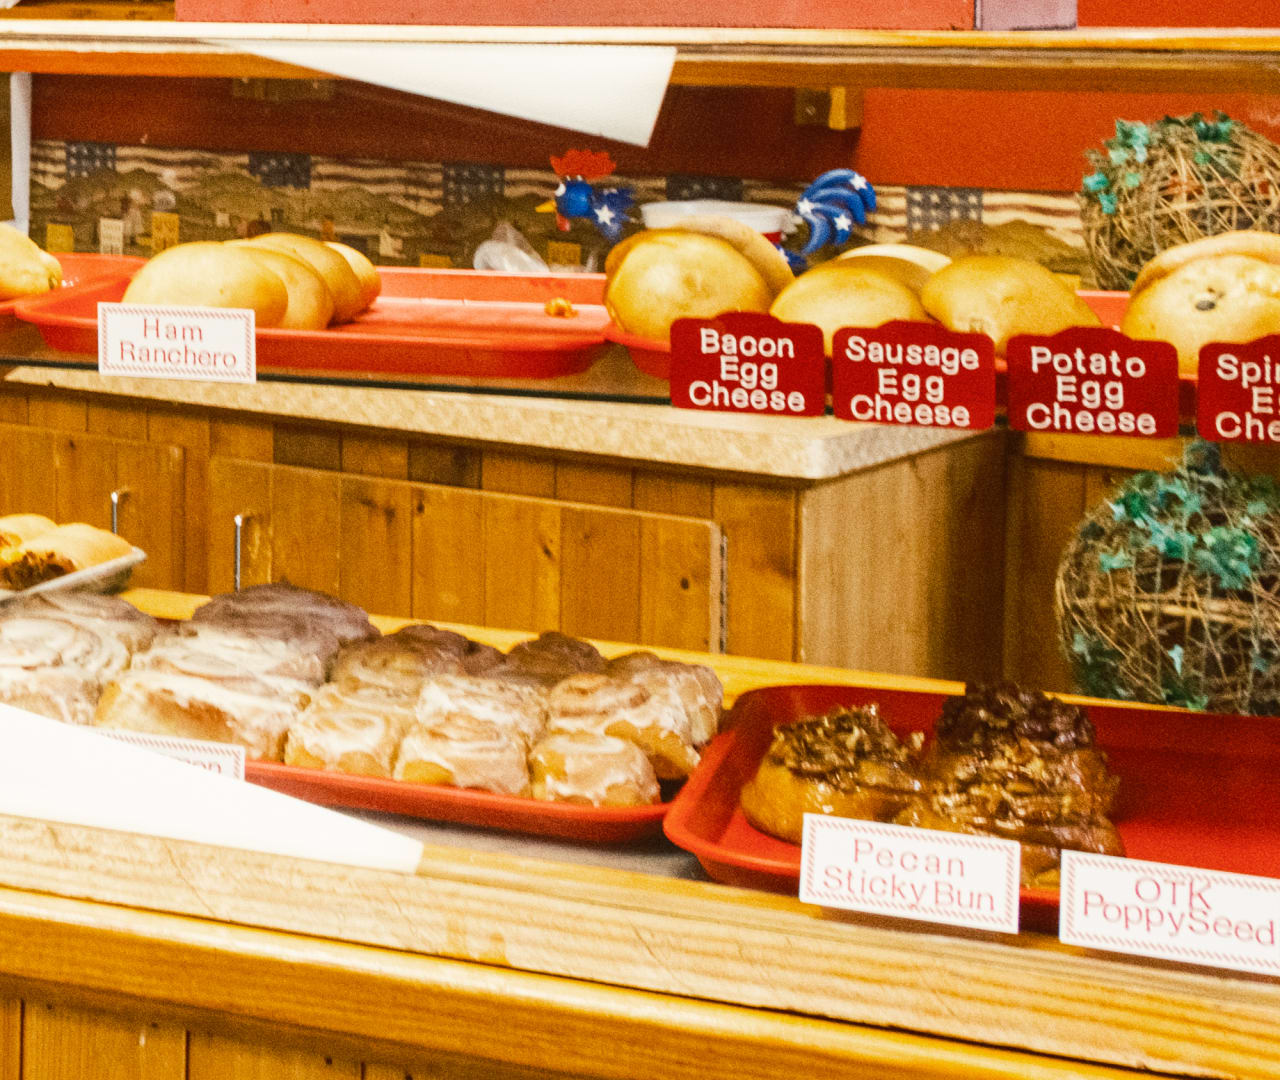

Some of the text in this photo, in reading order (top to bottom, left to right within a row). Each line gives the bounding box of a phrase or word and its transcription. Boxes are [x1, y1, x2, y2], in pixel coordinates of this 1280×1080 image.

[142, 317, 204, 342] Ham
[699, 327, 795, 359] Bacon
[119, 340, 238, 368] Ranchero
[844, 335, 980, 376] Sausage
[1030, 345, 1147, 379] Potato
[1215, 353, 1280, 389] Spi
[719, 355, 779, 390] Egg
[877, 367, 945, 404] Egg
[688, 380, 806, 412] Cheese
[1055, 374, 1124, 410] Egg
[849, 393, 971, 428] Cheese
[1025, 401, 1157, 435] Cheese
[852, 837, 967, 877] Pecan
[1134, 876, 1214, 911] OTK
